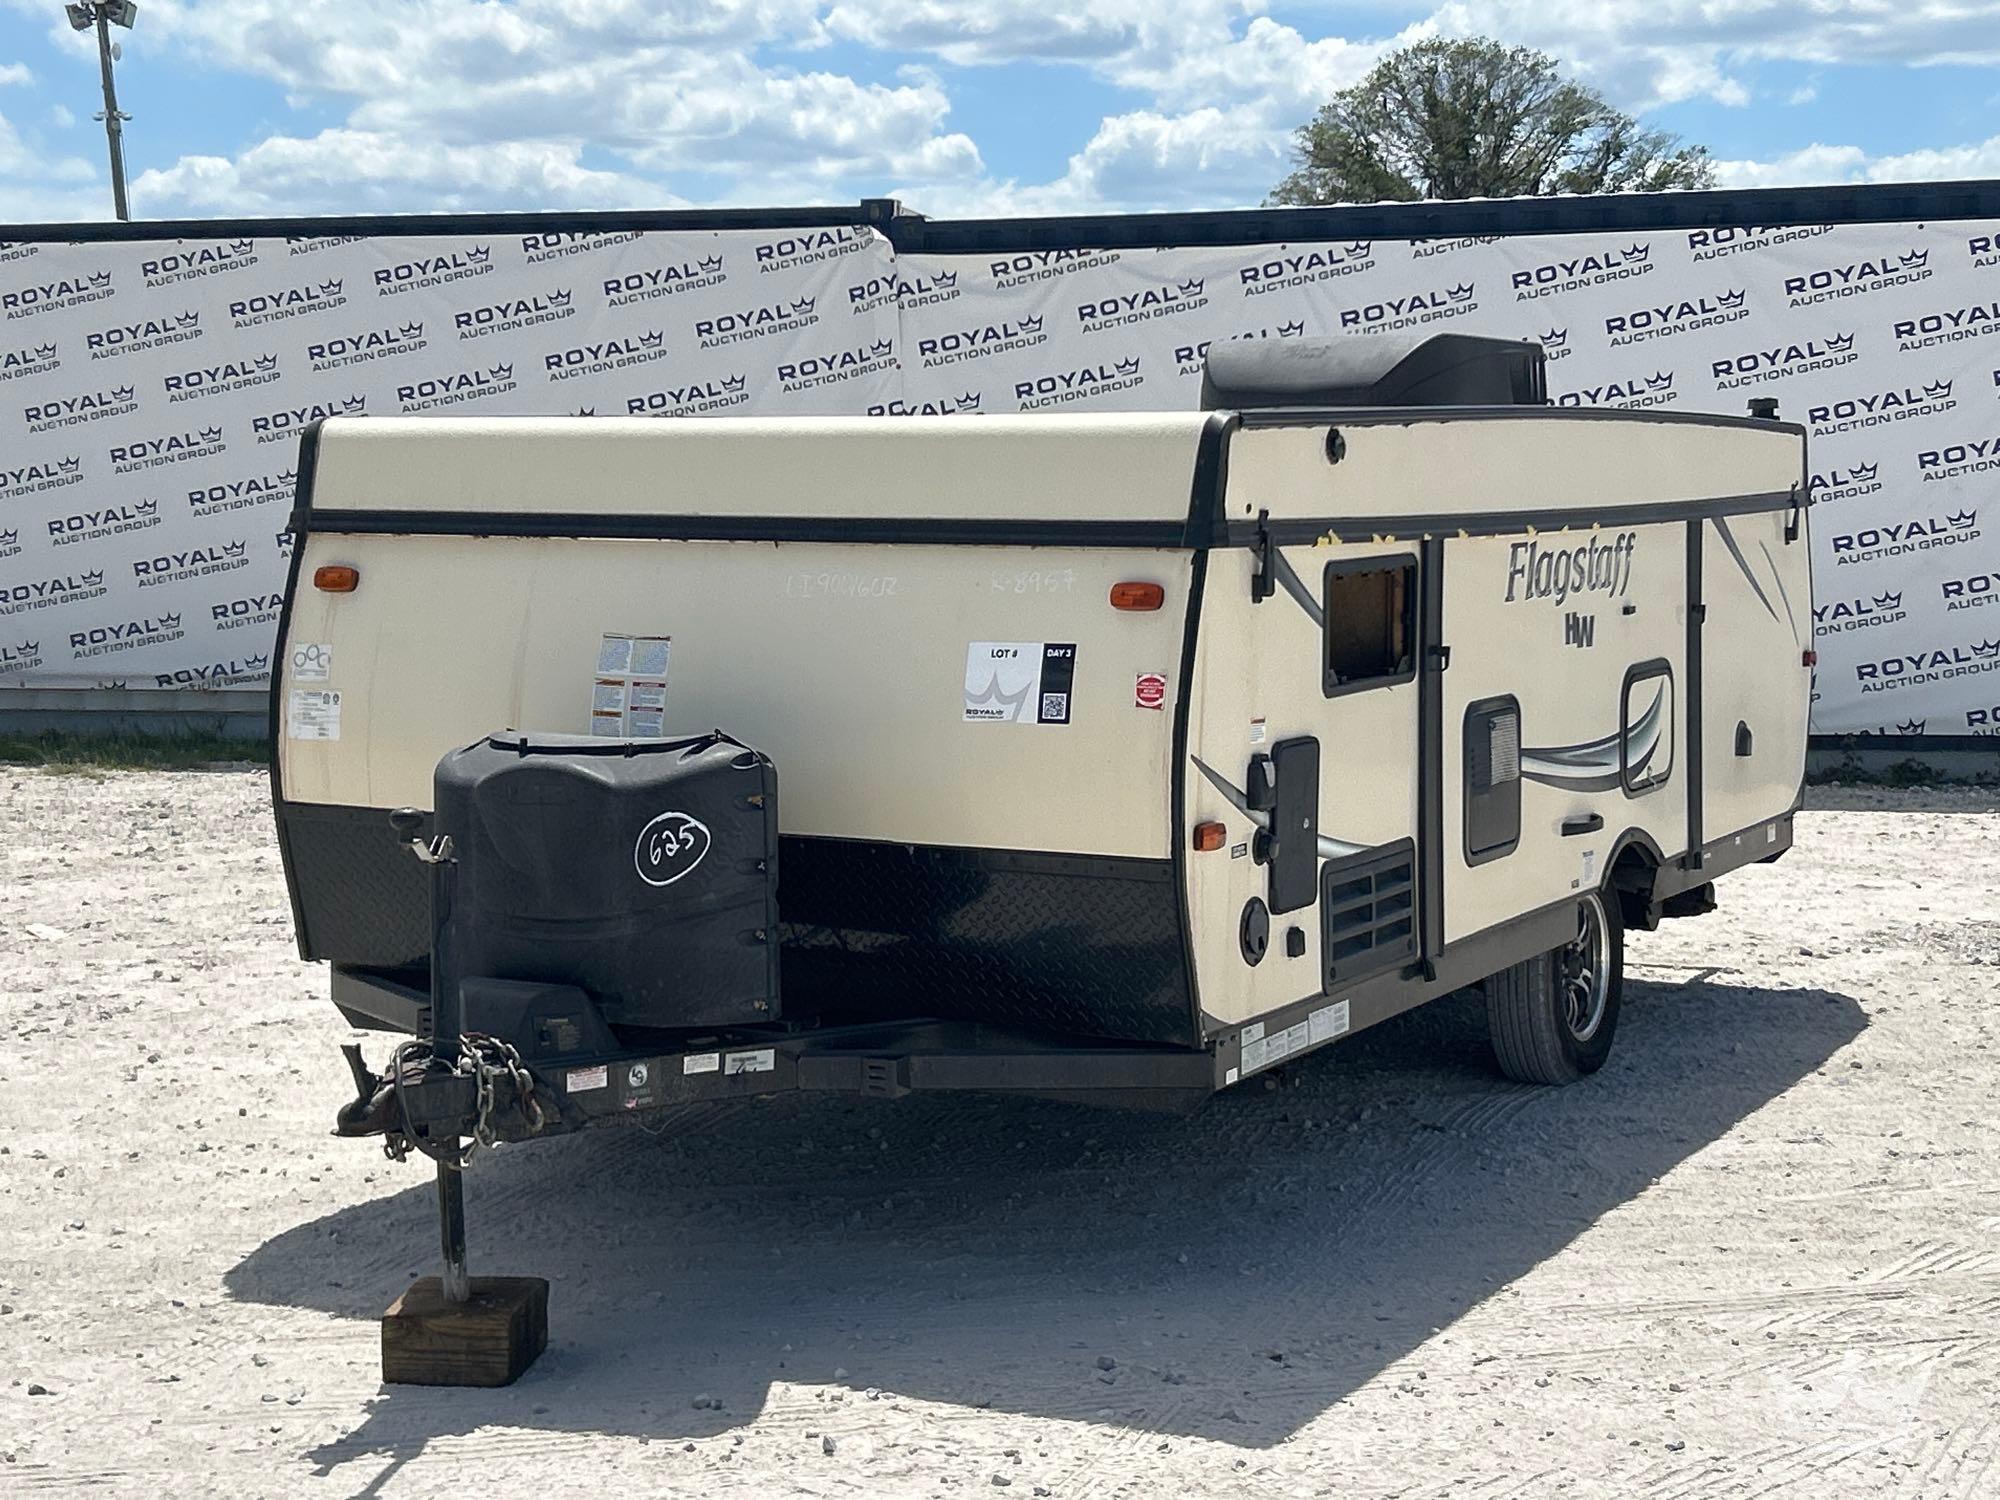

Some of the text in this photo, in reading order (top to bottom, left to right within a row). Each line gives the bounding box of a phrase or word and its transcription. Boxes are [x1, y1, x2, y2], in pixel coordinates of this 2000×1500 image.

[0, 247, 38, 262] ROUP
[142, 244, 232, 277] ROYAL
[527, 242, 590, 264] AUCTION
[756, 228, 853, 262] ROYAL
[761, 238, 874, 273] AUCTION GROUP
[1694, 238, 1768, 262] AUCTION
[147, 257, 258, 288] AUCTION GROUP
[374, 252, 469, 285] ROYAL
[379, 265, 493, 296] AUCTION GROUP
[604, 264, 698, 295] ROYAL
[997, 254, 1120, 289] AUCTION GROUP
[1240, 250, 1344, 284] ROYAL
[1245, 261, 1375, 296] AUCTION GROUP
[1512, 253, 1621, 289] ROYAL
[1785, 259, 1899, 295] ROYAL
[2, 279, 88, 309] ROYAL
[609, 274, 726, 307] AUCTION GROUP
[1517, 264, 1653, 302] AUCTION GROUP
[1790, 270, 1932, 308] AUCTION GROUP
[8, 289, 114, 320] AUCTION GROUP
[230, 284, 322, 317] ROYAL
[235, 298, 346, 328] AUCTION GROUP
[455, 298, 548, 328] ROYAL
[907, 290, 959, 308] GROUP
[1078, 288, 1178, 321] ROYAL
[1341, 292, 1447, 327] ROYAL
[1421, 303, 1478, 322] GROUP
[460, 308, 575, 340] AUCTION GROUP
[696, 305, 791, 337] ROYAL
[1083, 298, 1208, 334] AUCTION GROUP
[1606, 299, 1717, 334] ROYAL
[1610, 310, 1749, 347] AUCTION GROUP
[87, 317, 178, 349] ROYAL
[92, 330, 202, 360] AUCTION GROUP
[308, 328, 403, 360] ROYAL
[701, 316, 818, 349] AUCTION GROUP
[919, 324, 1018, 356] ROYAL
[1900, 328, 1978, 352] AUCTION
[313, 341, 426, 371] AUCTION GROUP
[546, 339, 639, 370] ROYAL
[550, 350, 666, 381] AUCTION GROUP
[778, 349, 870, 381] ROYAL
[924, 334, 1047, 368] AUCTION GROUP
[1712, 342, 1825, 378] ROYAL
[15, 361, 60, 377] GROUP
[165, 360, 256, 391] ROYAL
[783, 358, 896, 392] AUCTION GROUP
[1016, 366, 1114, 398] ROYAL
[1717, 354, 1858, 390] AUCTION GROUP
[170, 372, 280, 403] AUCTION GROUP
[398, 369, 491, 402] ROYAL
[402, 382, 516, 412] AUCTION GROUP
[628, 383, 721, 414] ROYAL
[1020, 377, 1143, 411] AUCTION GROUP
[25, 391, 114, 422] ROYAL
[253, 401, 345, 432] ROYAL
[698, 394, 749, 411] GROUP
[1809, 389, 1923, 424] ROYAL
[30, 404, 138, 433] AUCTION GROUP
[1814, 400, 1956, 437] AUCTION GROUP
[110, 431, 202, 463] ROYAL
[115, 444, 226, 474] AUCTION GROUP
[38, 474, 83, 490] GROUP
[188, 477, 278, 506] ROYAL
[1821, 483, 1882, 502] GROUP
[194, 488, 296, 517] AUCTION GROU
[48, 507, 135, 535] ROYAL
[53, 518, 161, 546] AUCTION GROUP
[1833, 519, 1947, 553] ROYAL
[134, 548, 223, 576] ROYAL
[1838, 530, 1980, 565] AUCTION GROUP
[139, 559, 249, 588] AUCTION GROUP
[1504, 532, 1637, 606] Flagstaff
[60, 588, 107, 603] GROUP
[212, 593, 284, 620] ROYA
[1814, 600, 1873, 622] YAL
[1948, 594, 2000, 611] AUCTI
[70, 620, 158, 648] ROYAL
[217, 612, 276, 630] AUCTION
[1845, 612, 1906, 630] GROUP
[74, 631, 184, 659] AUCTION GROUP
[991, 649, 1010, 658] LOT
[1047, 649, 1065, 657] DAY
[155, 662, 244, 688] ROYAL
[1856, 648, 1971, 680] ROYAL
[1862, 672, 1939, 693] AUCTION
[649, 821, 695, 865] 625
